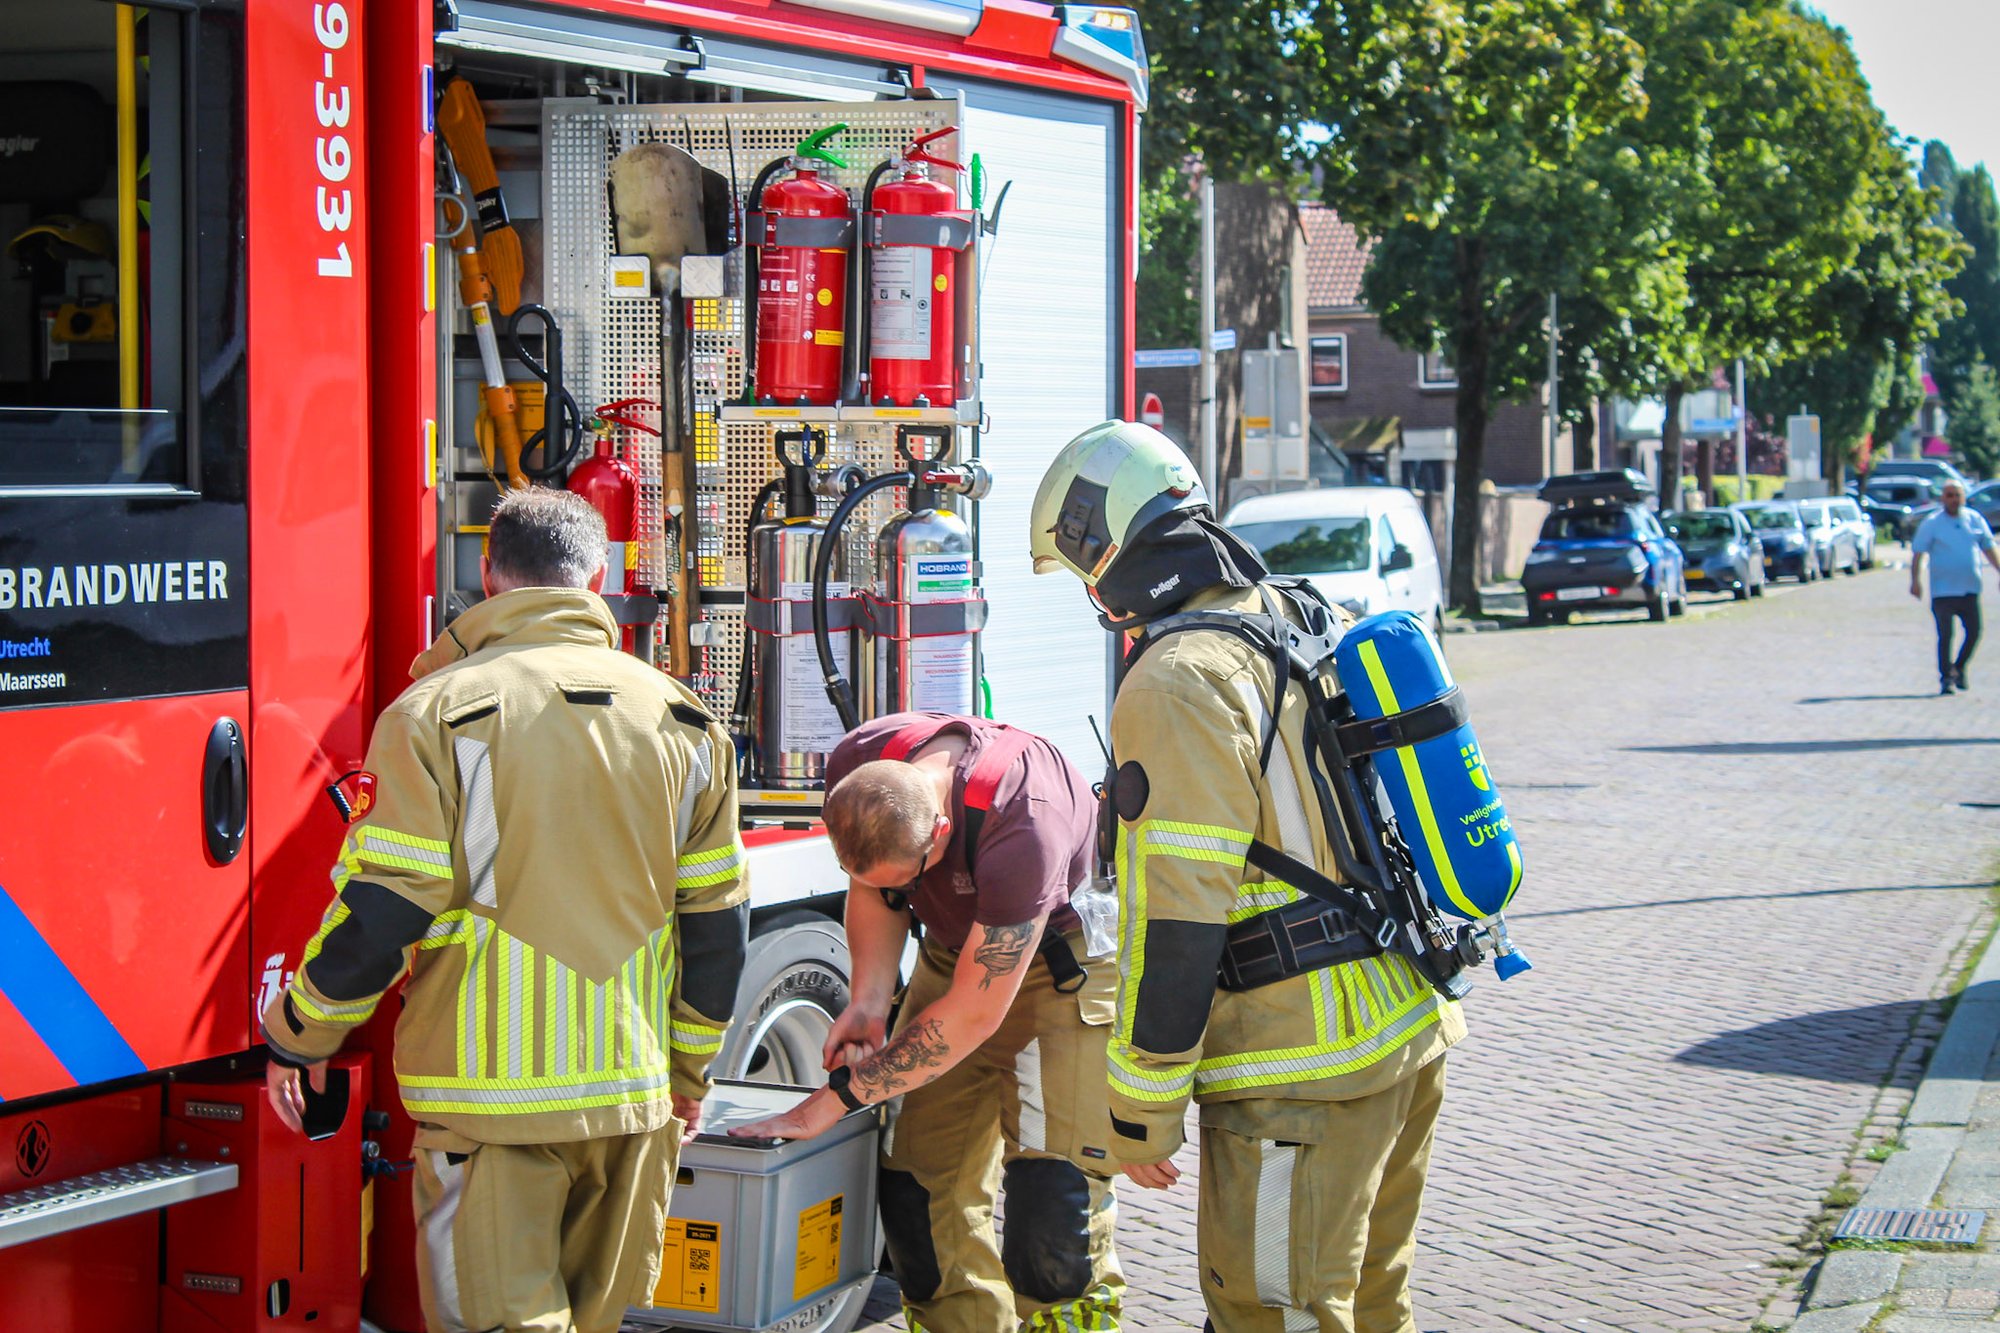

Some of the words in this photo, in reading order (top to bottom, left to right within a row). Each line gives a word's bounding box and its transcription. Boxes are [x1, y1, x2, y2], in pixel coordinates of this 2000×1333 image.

[314, 2, 353, 278] 9-3931
[0, 560, 229, 610] BRANDWEER
[920, 563, 967, 573] HOBRAND
[0, 672, 66, 691] Maarssen
